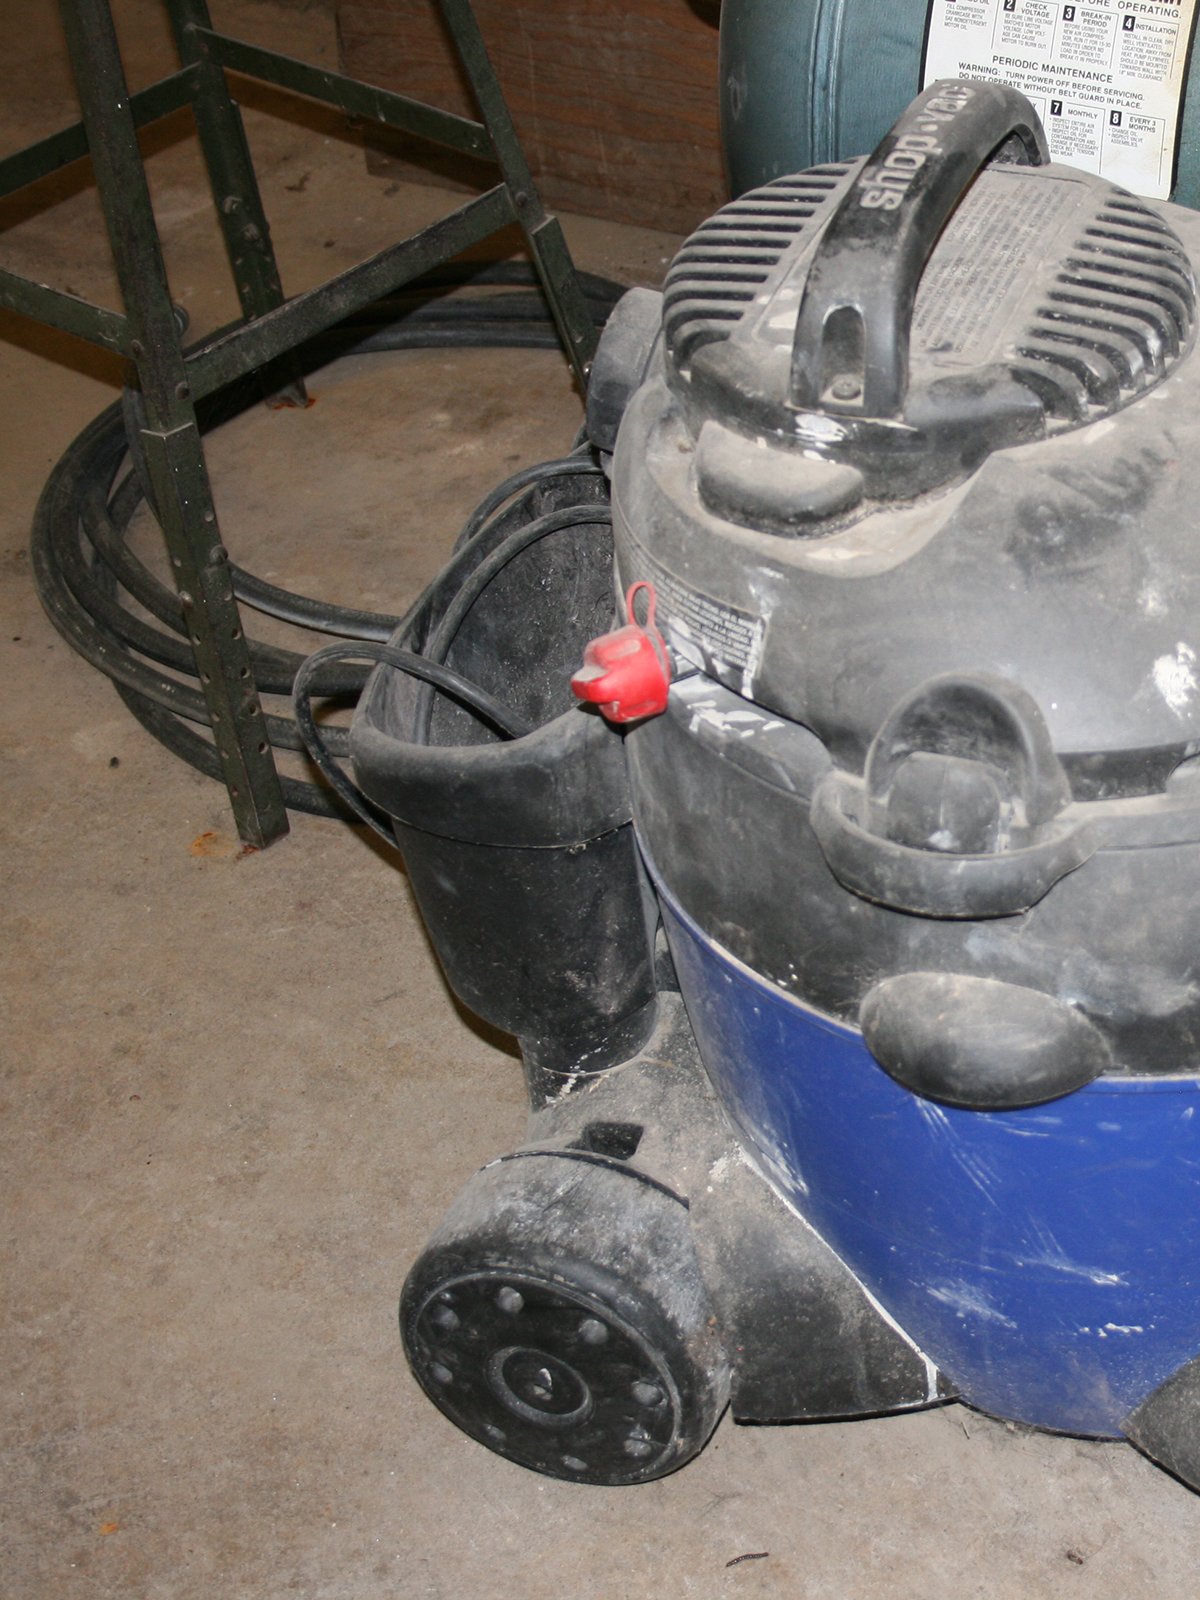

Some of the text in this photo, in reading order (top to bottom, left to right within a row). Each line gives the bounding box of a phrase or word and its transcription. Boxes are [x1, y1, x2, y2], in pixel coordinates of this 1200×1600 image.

[1025, 2, 1048, 11] CHECK
[1118, 1, 1182, 19] OPERATING.
[1021, 8, 1050, 18] VOLTAGE
[1065, 8, 1073, 19] 3
[1081, 11, 1112, 21] BREAK-IN
[1083, 18, 1107, 28] PERIOD
[1125, 18, 1133, 29] 4
[1135, 23, 1176, 35] INSTALLATION
[992, 55, 1113, 83] PERIODIC MAINTENANCE
[958, 61, 1144, 101] WARNING: TURN POWER OFF BEFORE SERVICING.
[958, 72, 969, 80] DO
[989, 77, 1021, 89] OPERATE
[1023, 82, 1056, 94] WITHOUT
[1058, 88, 1079, 98] BELT
[1078, 92, 1104, 103] GUARD
[1106, 95, 1114, 104] IN
[1116, 99, 1142, 109] PLACE.
[1052, 102, 1059, 113] 7
[1068, 109, 1098, 119] MONTHLY
[1112, 113, 1120, 124] 8
[1130, 116, 1151, 126] EVERY
[1128, 123, 1156, 133] MONTHS
